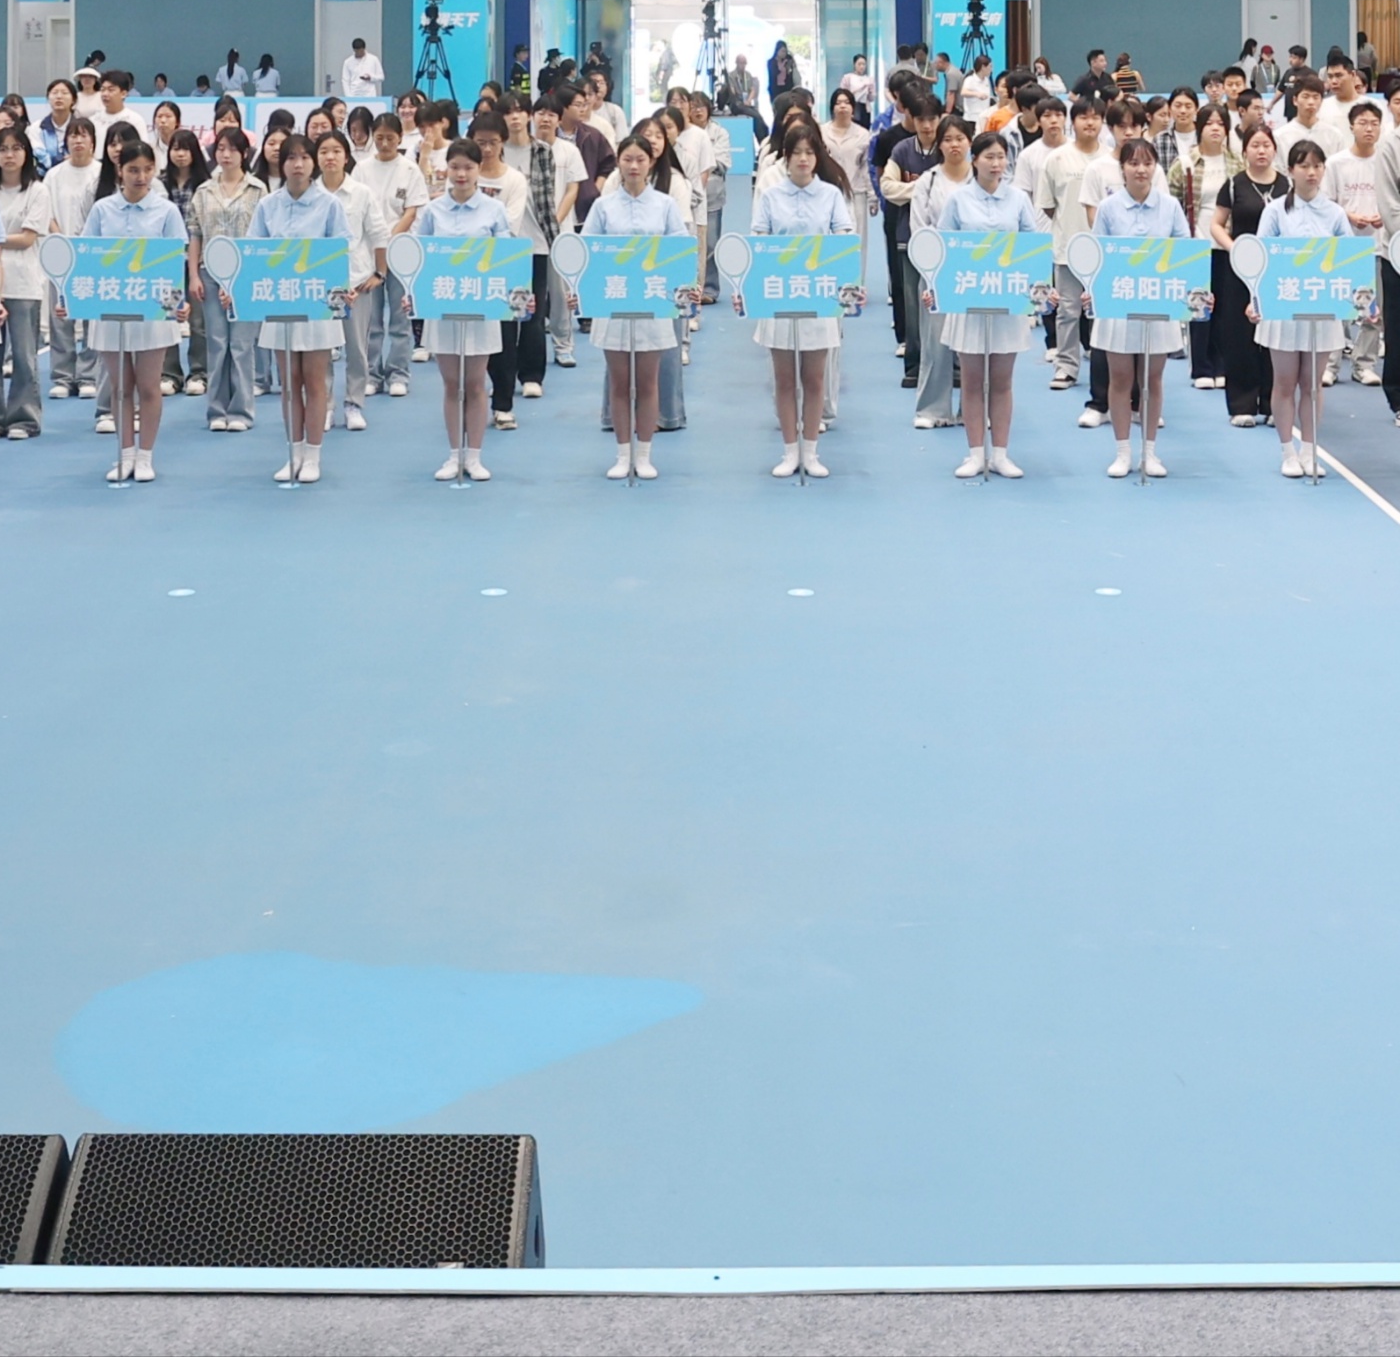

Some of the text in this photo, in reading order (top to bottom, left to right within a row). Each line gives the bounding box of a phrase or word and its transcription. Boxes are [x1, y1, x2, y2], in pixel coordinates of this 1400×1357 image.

[70, 276, 175, 301] 攀枝花市
[251, 278, 326, 301] 成都市
[432, 275, 507, 301] 裁判员
[764, 274, 837, 299] 自贡市
[954, 270, 1030, 296] 泸州市
[1112, 276, 1187, 301] 绵阳市
[1277, 276, 1352, 301] 遂宁市
